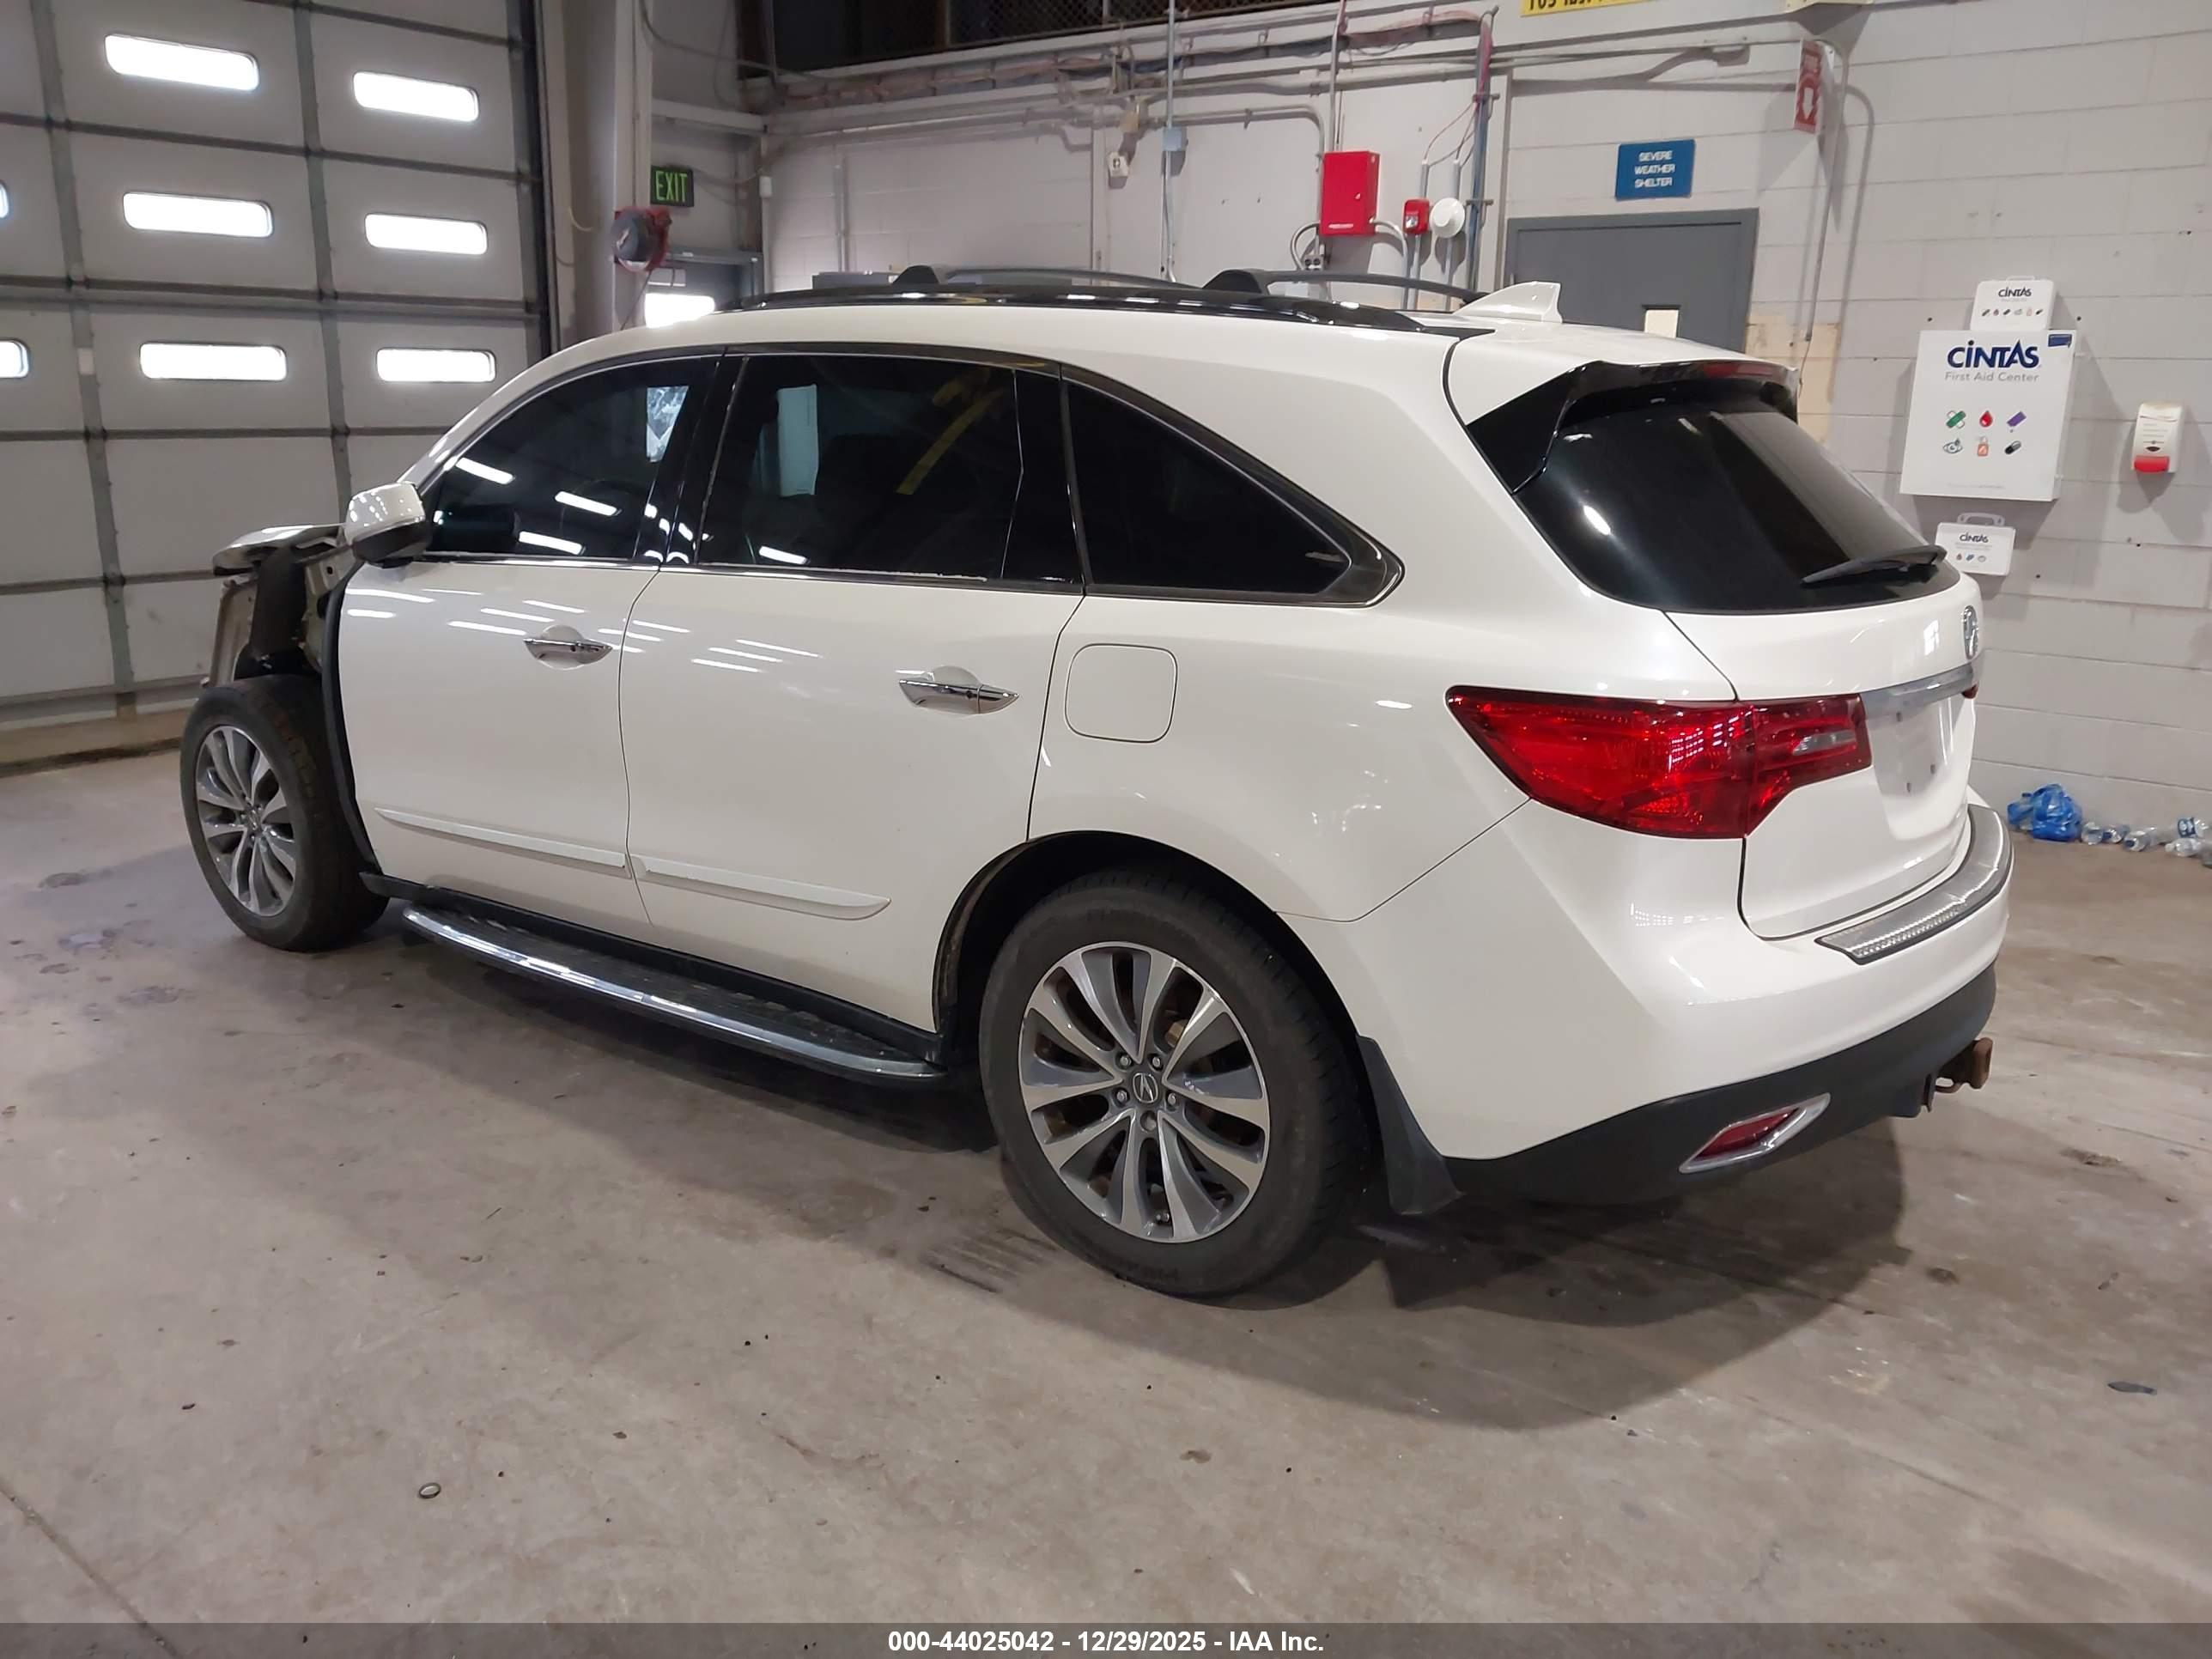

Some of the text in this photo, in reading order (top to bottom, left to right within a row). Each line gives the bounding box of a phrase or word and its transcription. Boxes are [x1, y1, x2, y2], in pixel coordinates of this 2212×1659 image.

[1638, 151, 1673, 161] SEVERE
[1634, 164, 1675, 174] WEATHER
[655, 171, 688, 203] EXIT
[1634, 177, 1673, 188] SHELTER
[1974, 372, 1994, 381] Aid
[1998, 372, 2039, 381] Center
